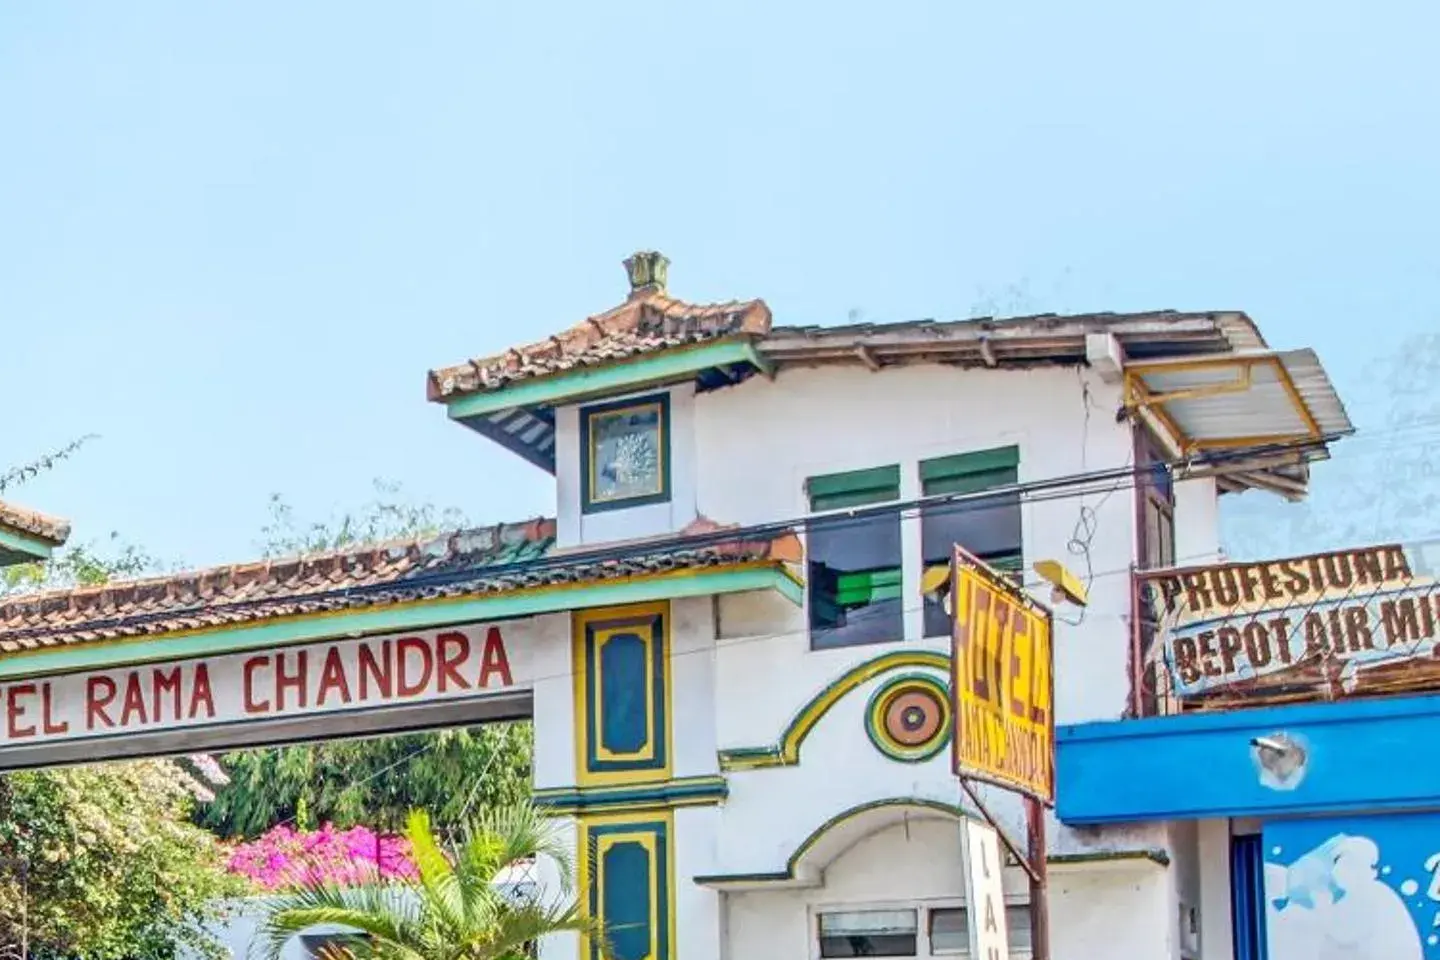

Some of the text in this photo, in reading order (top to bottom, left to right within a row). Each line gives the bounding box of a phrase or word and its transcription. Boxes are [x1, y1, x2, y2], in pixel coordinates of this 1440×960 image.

[87, 661, 215, 729] RAMA
[243, 626, 514, 714] CHANDRA
[1173, 594, 1440, 685] DEPOT AIR MI
